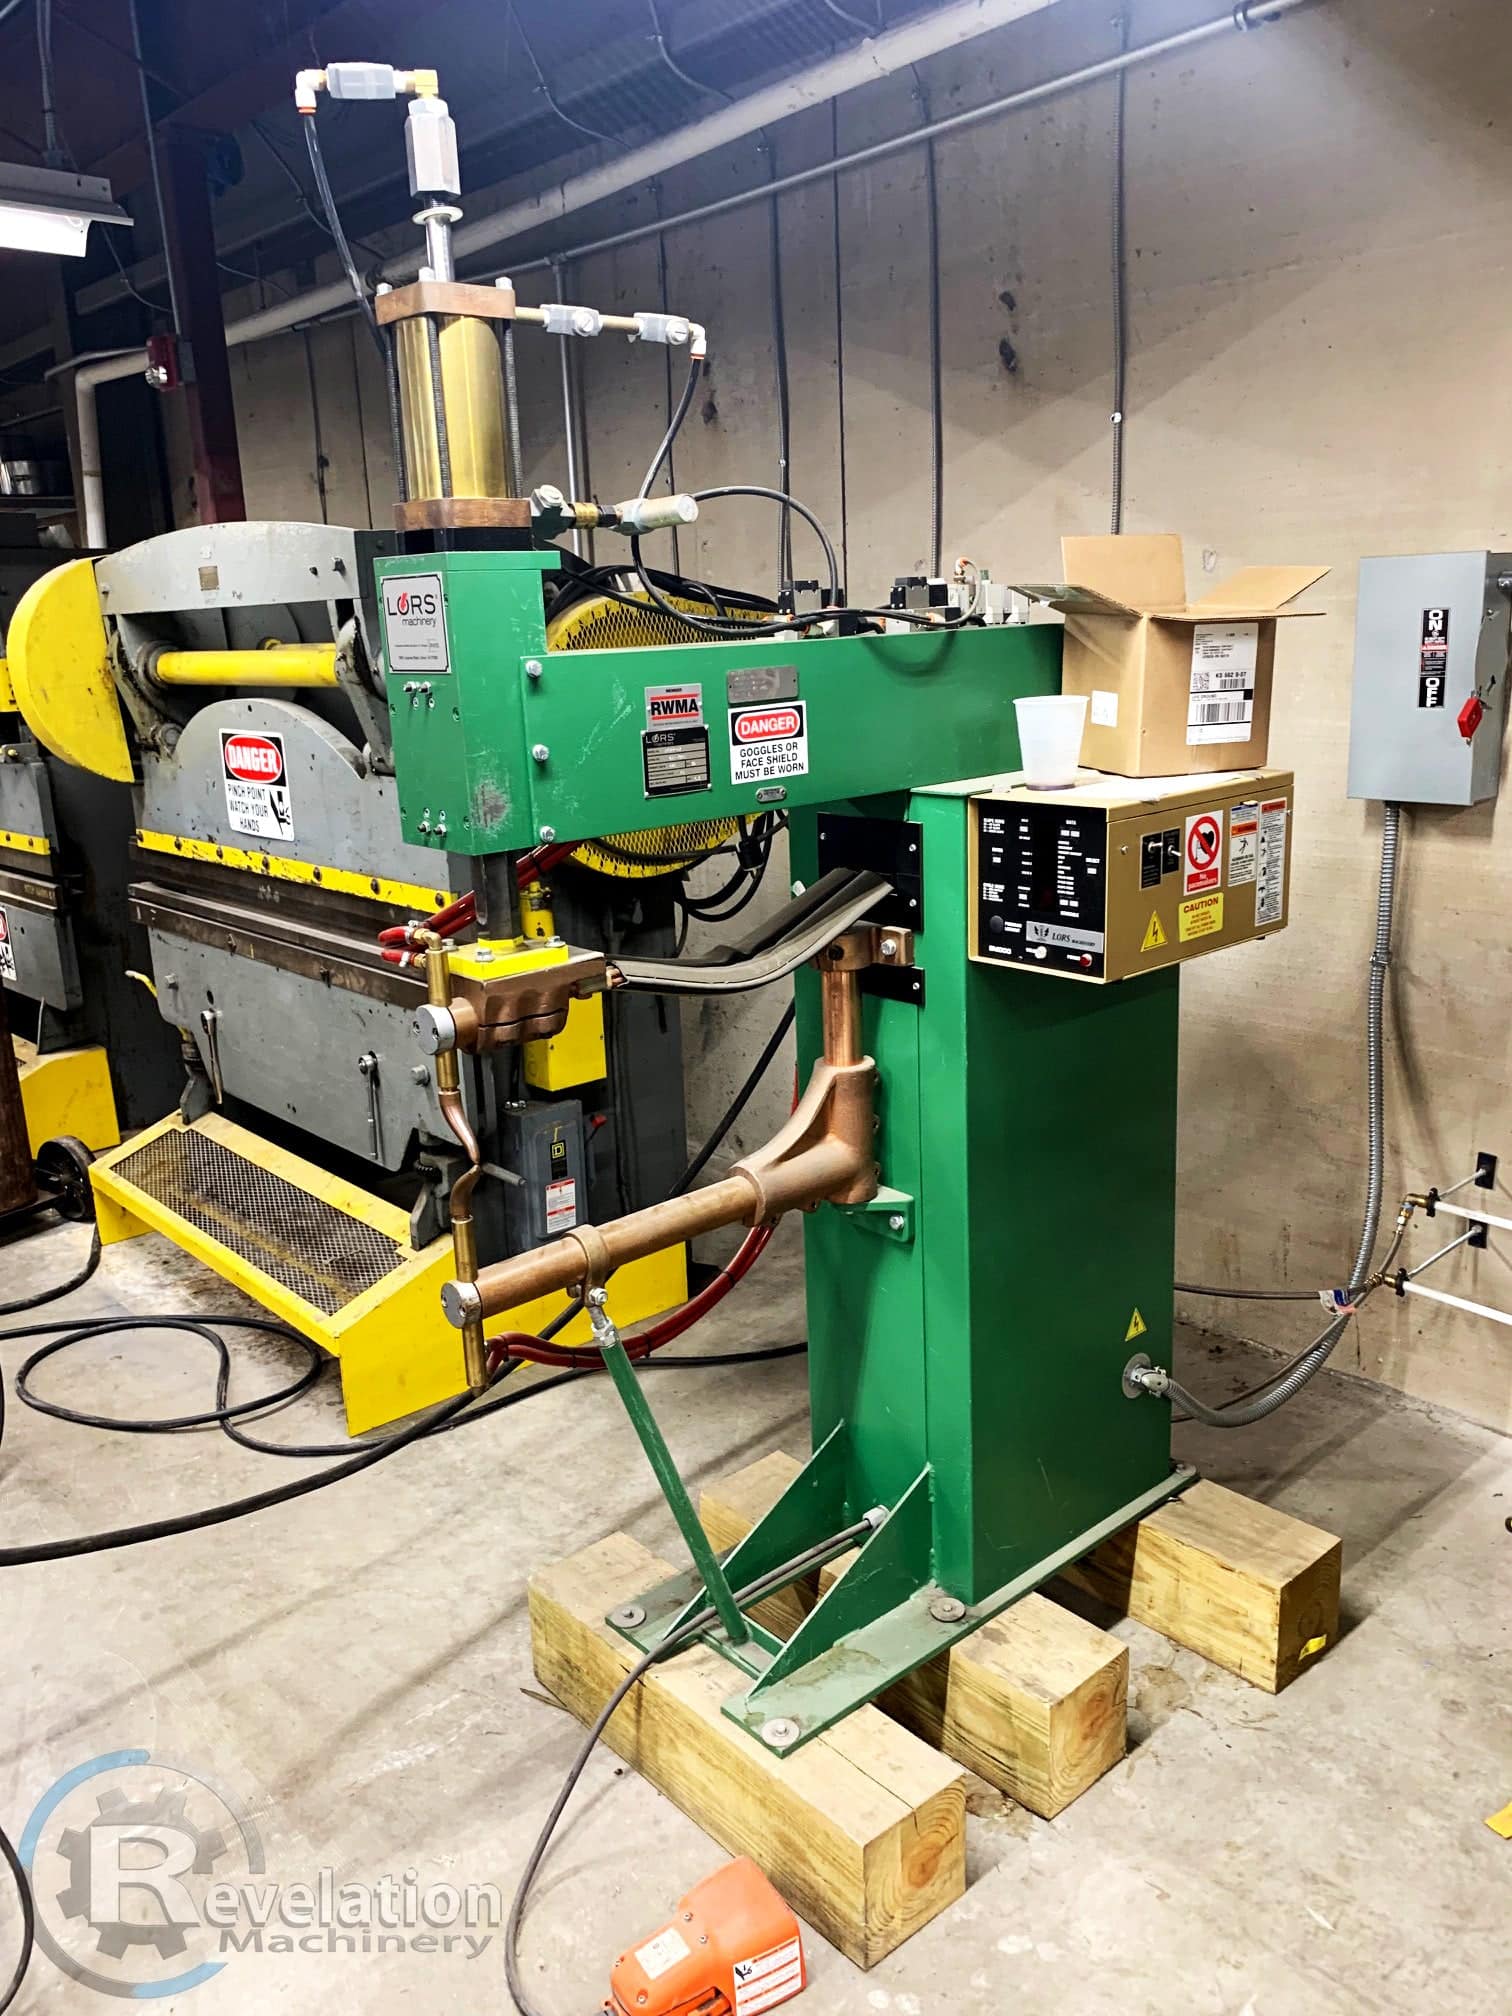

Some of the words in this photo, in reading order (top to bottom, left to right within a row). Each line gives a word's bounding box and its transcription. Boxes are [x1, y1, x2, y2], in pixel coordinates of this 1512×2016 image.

[387, 592, 436, 616] LORS
[401, 616, 437, 628] machinery
[1428, 609, 1444, 631] ON
[1425, 677, 1440, 708] OFF
[651, 698, 699, 715] RWMA
[740, 715, 795, 736] DANGER
[645, 733, 675, 744] LORS
[740, 743, 783, 758] GOGGLES
[785, 742, 799, 752] OR
[227, 744, 279, 774] DANGER
[741, 757, 764, 769] FACE
[766, 752, 798, 765] SHIELD
[735, 768, 760, 780] MUST
[763, 766, 775, 776] BE
[778, 762, 804, 774] WORN
[228, 783, 246, 797] PINCH
[247, 786, 265, 801] POINT
[229, 799, 249, 814] WATCH
[251, 804, 269, 817] YOUR
[240, 817, 260, 833] HANDS
[1183, 897, 1219, 914] CAUTION
[1052, 932, 1071, 943] LORS
